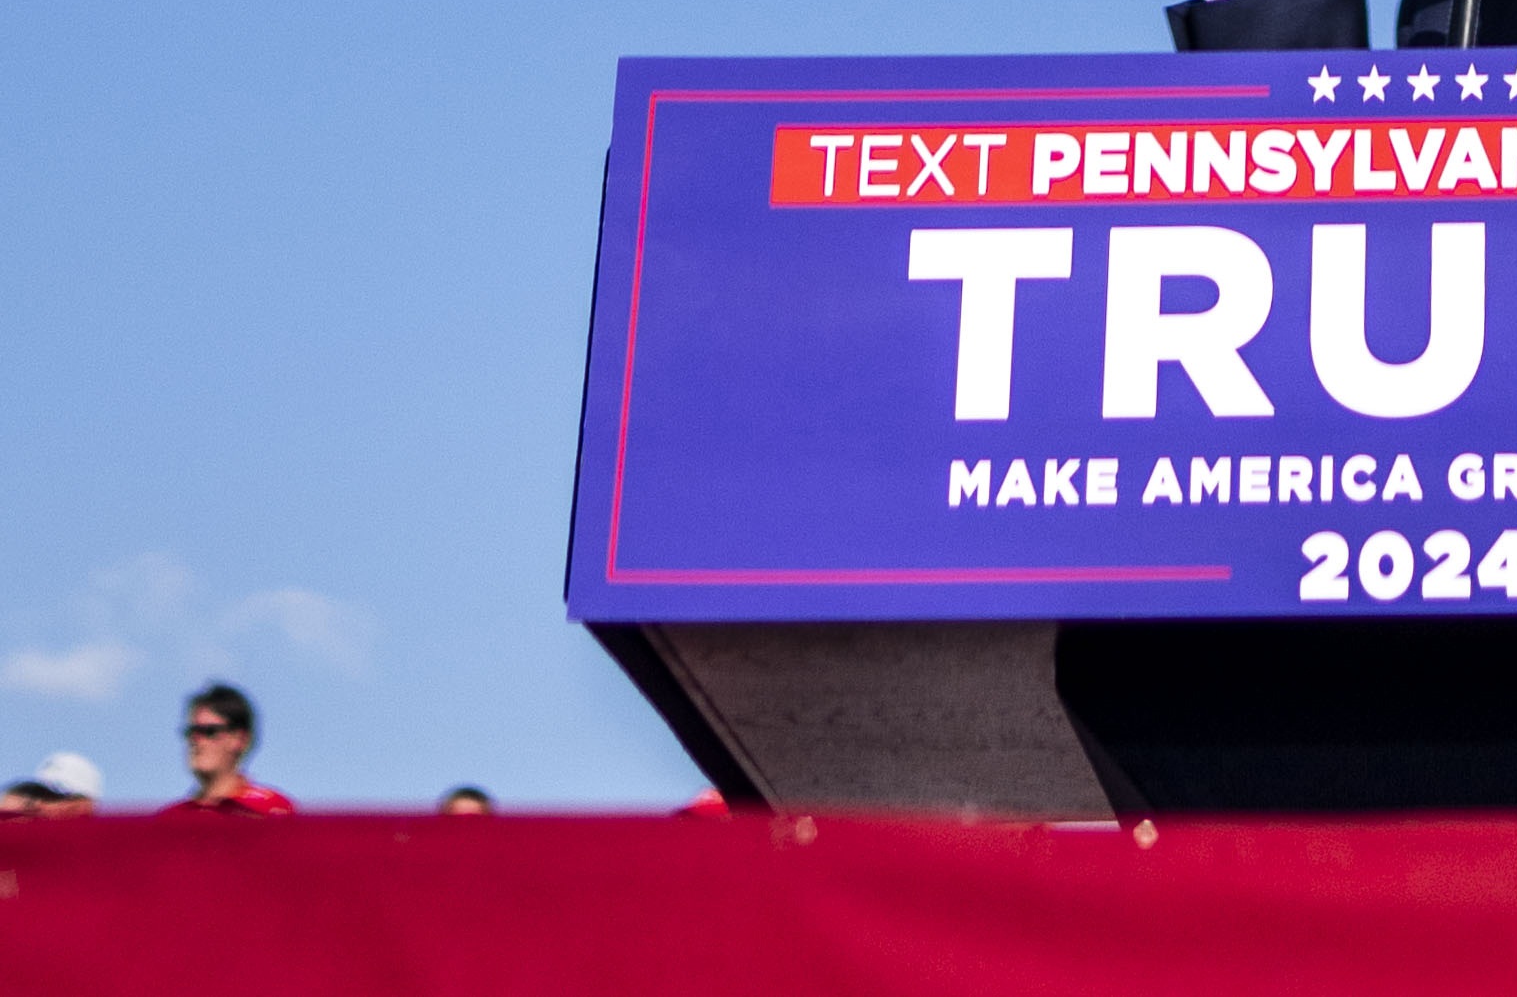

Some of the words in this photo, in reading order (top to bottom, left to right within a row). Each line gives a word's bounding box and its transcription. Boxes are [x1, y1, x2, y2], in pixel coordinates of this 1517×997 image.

[809, 133, 1008, 197] TEXT
[948, 458, 1119, 508] MAKE
[1141, 454, 1423, 505] AMERICA
